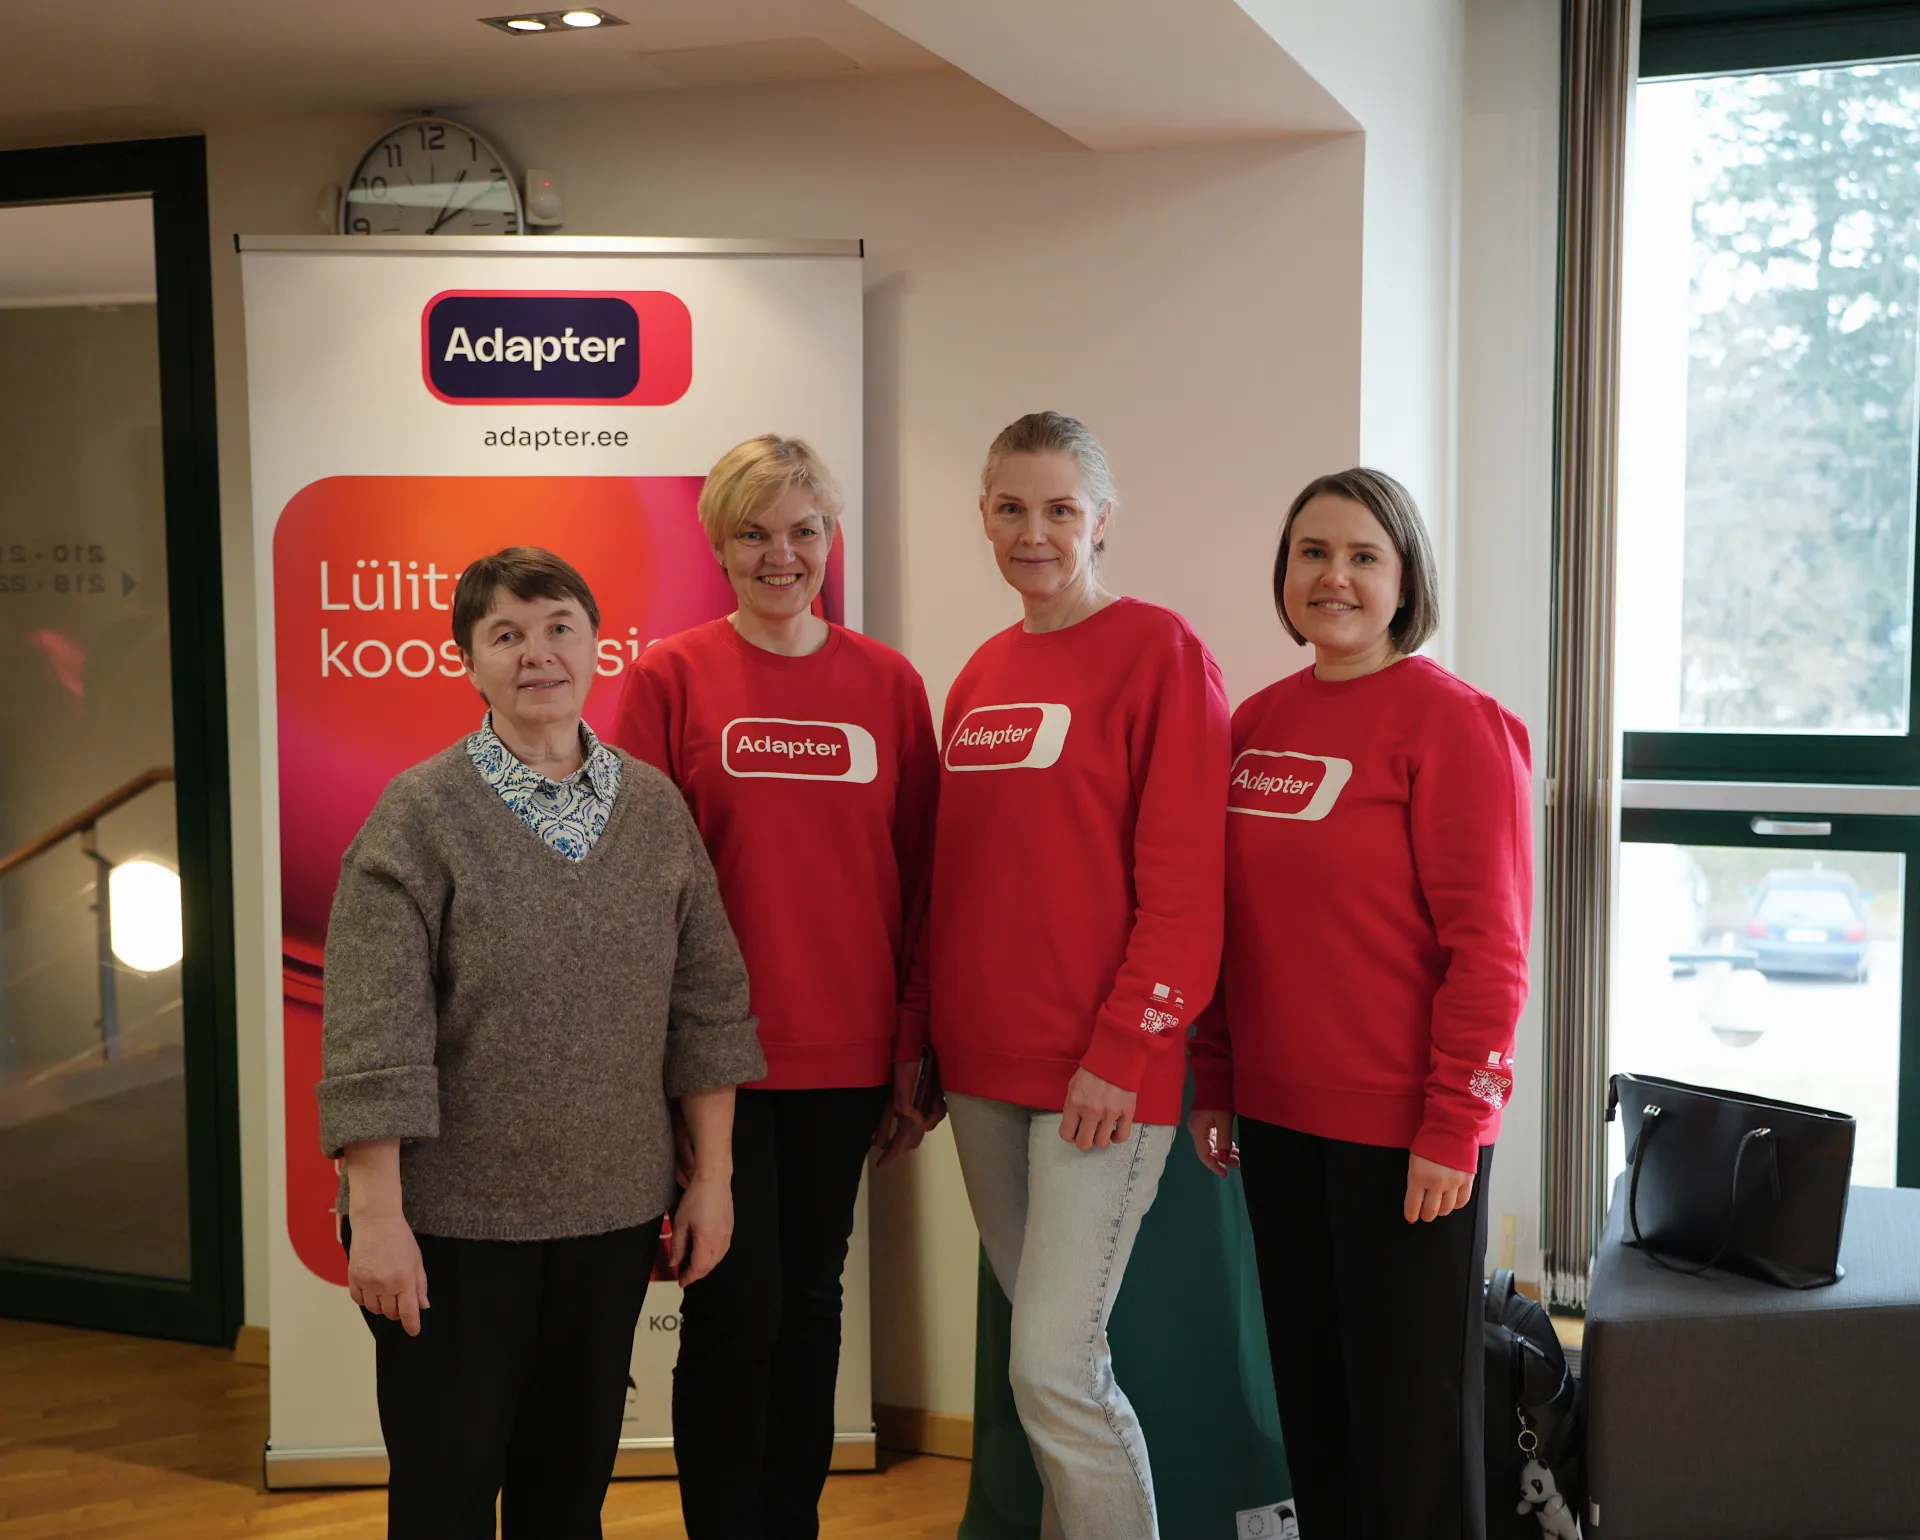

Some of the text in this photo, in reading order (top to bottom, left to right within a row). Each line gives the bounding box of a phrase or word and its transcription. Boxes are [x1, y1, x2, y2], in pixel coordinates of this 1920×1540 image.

[418, 126, 445, 150] 12
[469, 137, 476, 161] 1
[384, 144, 401, 168] 11
[361, 176, 387, 203] 10
[443, 326, 627, 372] Adapter
[484, 426, 629, 451] adapter.ee
[320, 559, 462, 612] Lülit
[320, 626, 662, 679] koos si
[735, 735, 842, 759] Adapter
[955, 724, 1033, 750] Adapter
[1231, 768, 1315, 796] Adapter
[649, 1314, 684, 1332] KO
